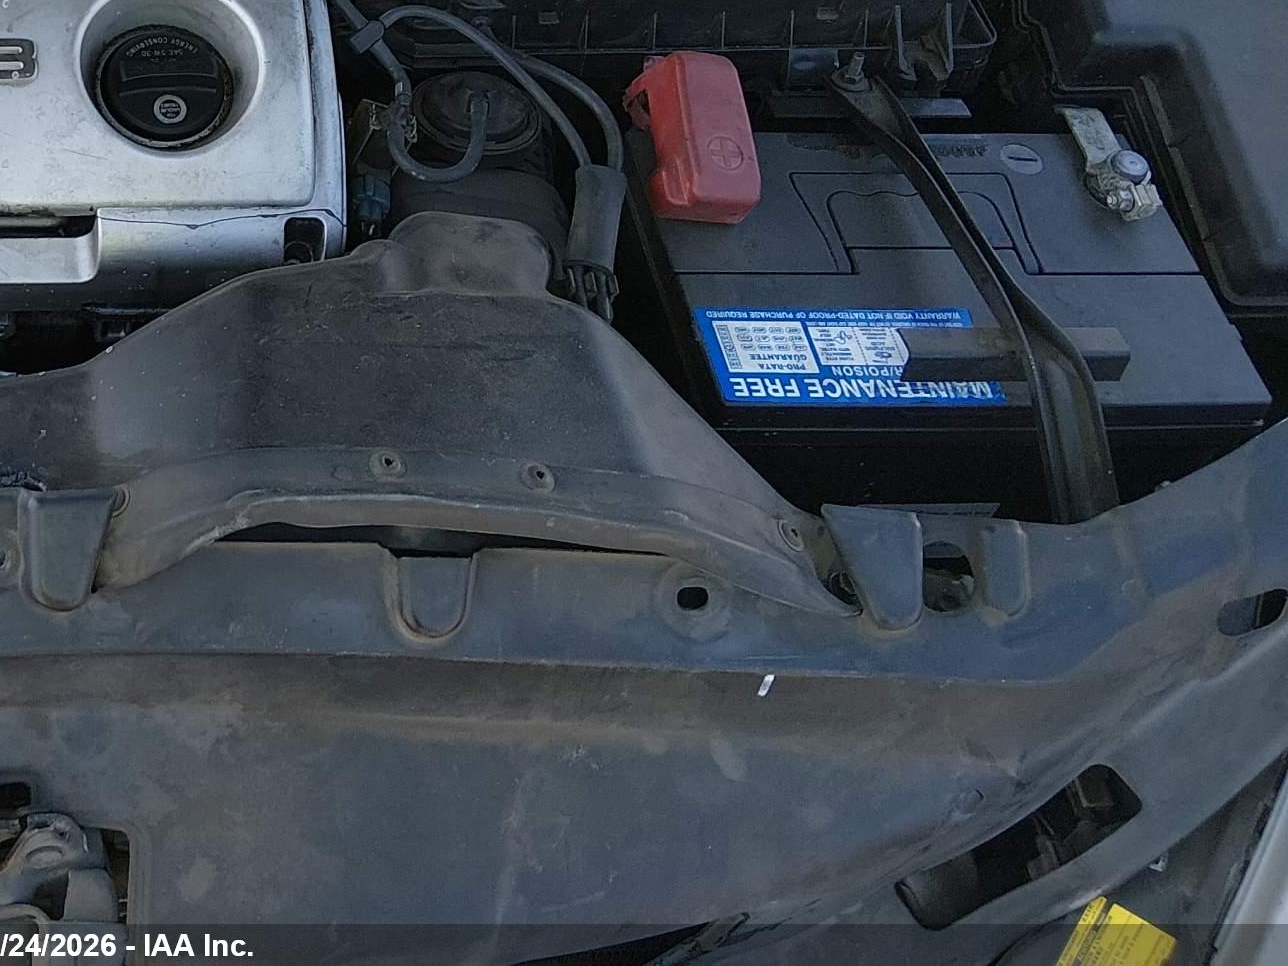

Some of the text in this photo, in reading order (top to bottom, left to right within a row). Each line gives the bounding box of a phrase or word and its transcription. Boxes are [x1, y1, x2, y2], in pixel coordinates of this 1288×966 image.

[126, 37, 168, 57] CONSERVING
[705, 310, 748, 318] REQUIRED
[749, 311, 794, 319] PURCHASE
[795, 311, 807, 319] OF
[894, 312, 913, 320] VOID
[915, 312, 961, 320] WARRANTY
[749, 353, 807, 361] GUARANTEE
[729, 378, 994, 399] MAINTENANCE FREE
